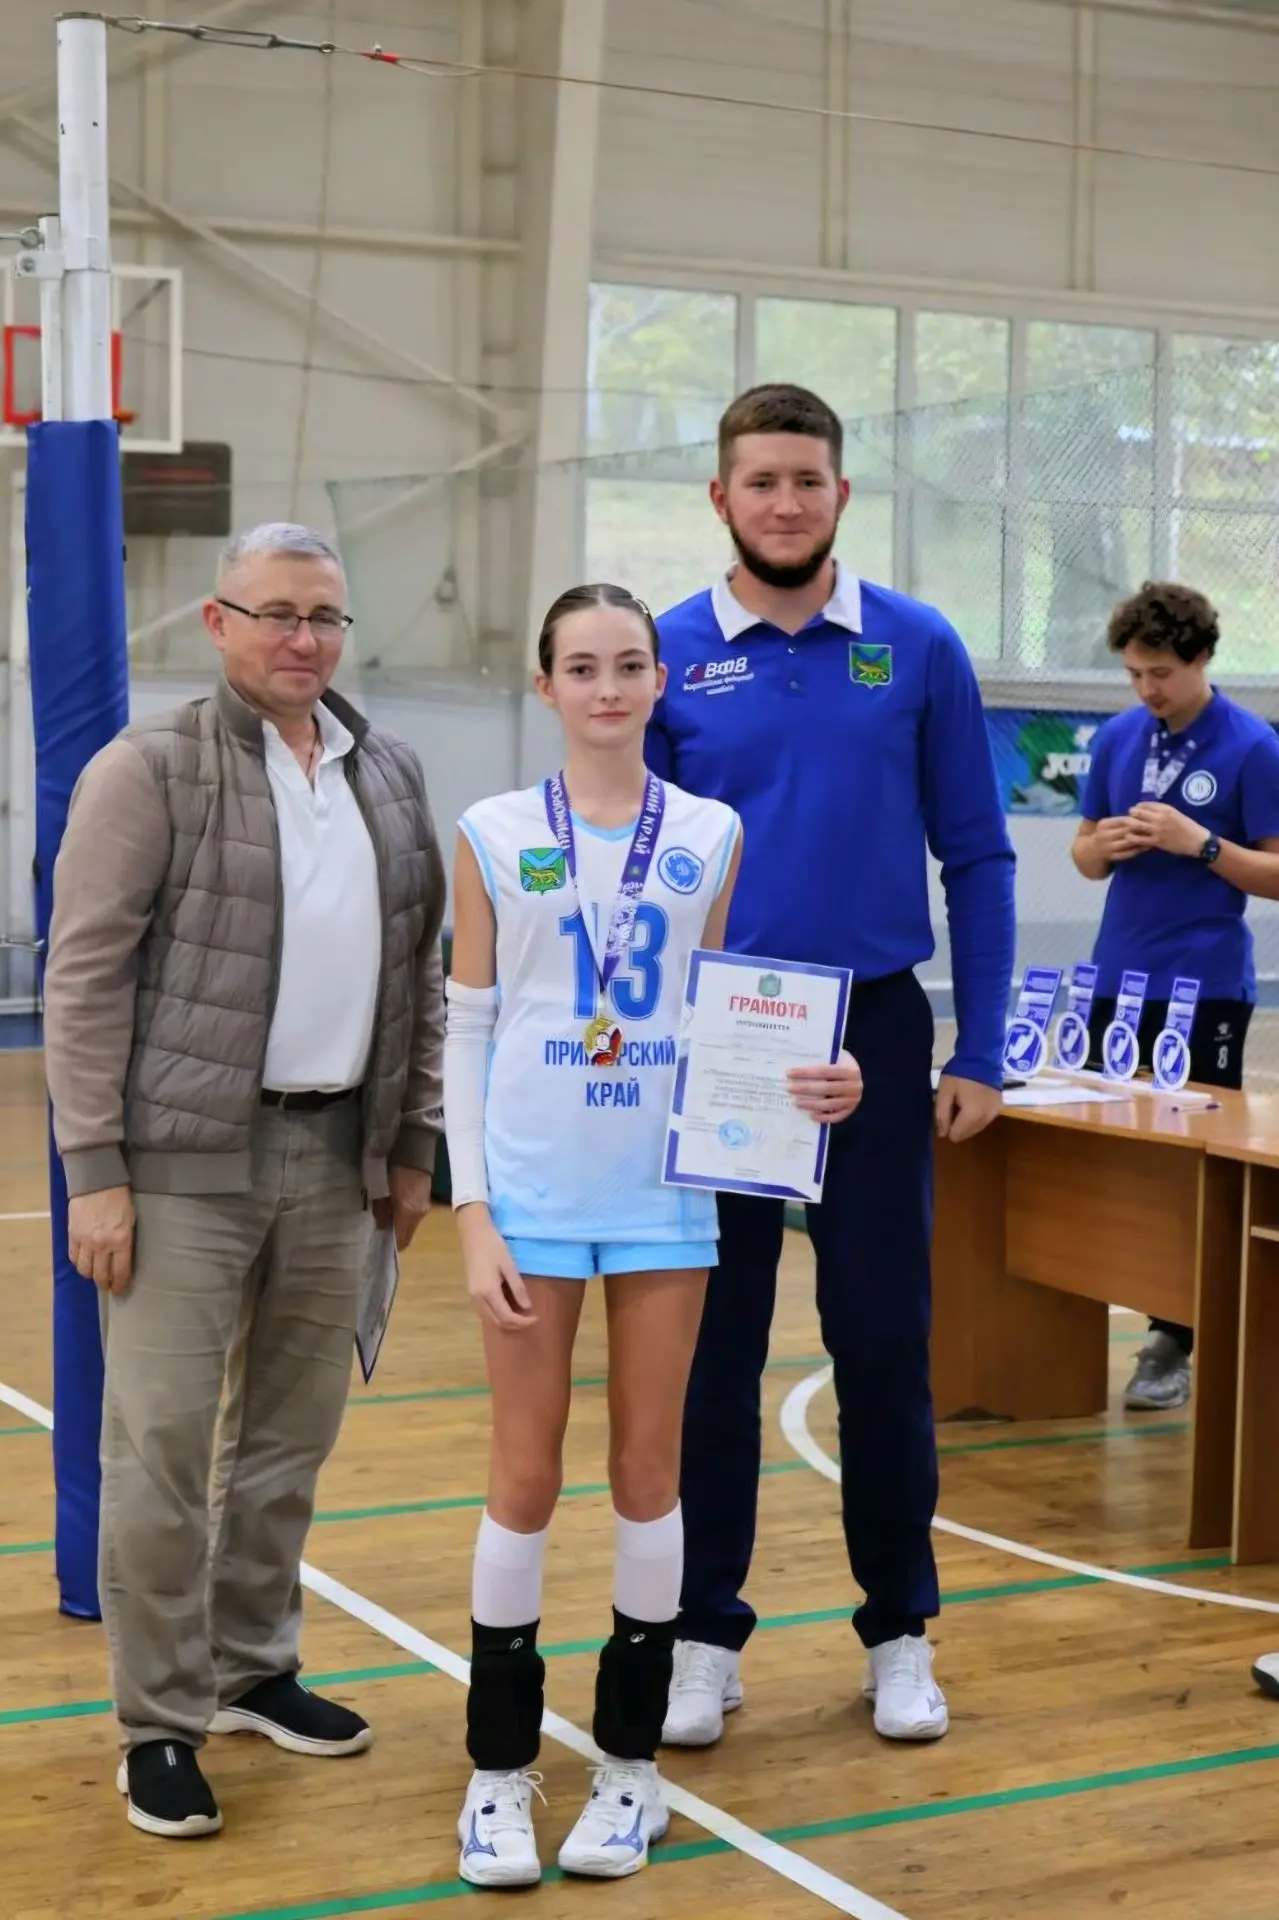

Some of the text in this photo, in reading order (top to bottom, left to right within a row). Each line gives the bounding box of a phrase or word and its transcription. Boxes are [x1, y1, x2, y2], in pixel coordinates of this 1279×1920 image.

[704, 656, 748, 678] ВФВ
[633, 815, 656, 855] КРАЙ
[559, 901, 669, 1020] 13
[729, 996, 808, 1021] ГРАМОТА
[545, 1035, 676, 1066] ПРИРСКИЙ
[586, 1077, 640, 1107] КРАЙ
